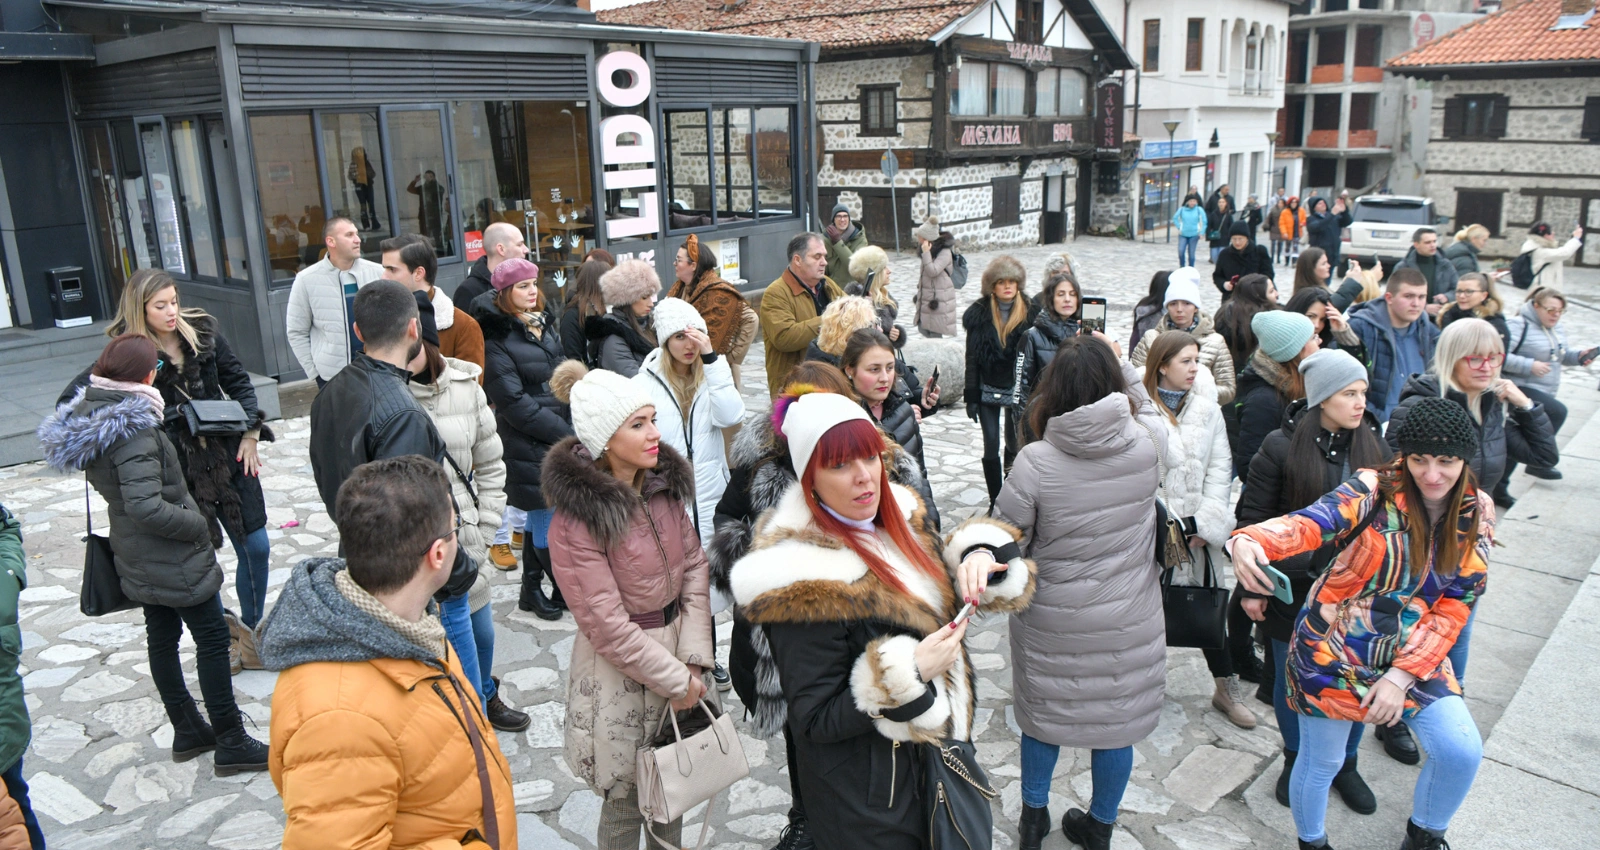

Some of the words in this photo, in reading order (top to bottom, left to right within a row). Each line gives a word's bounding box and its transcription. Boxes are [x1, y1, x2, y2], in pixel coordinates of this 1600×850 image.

[596, 50, 660, 240] LIDO
[961, 124, 1021, 146] МЕХАНА
[1104, 86, 1115, 147] TAVERN
